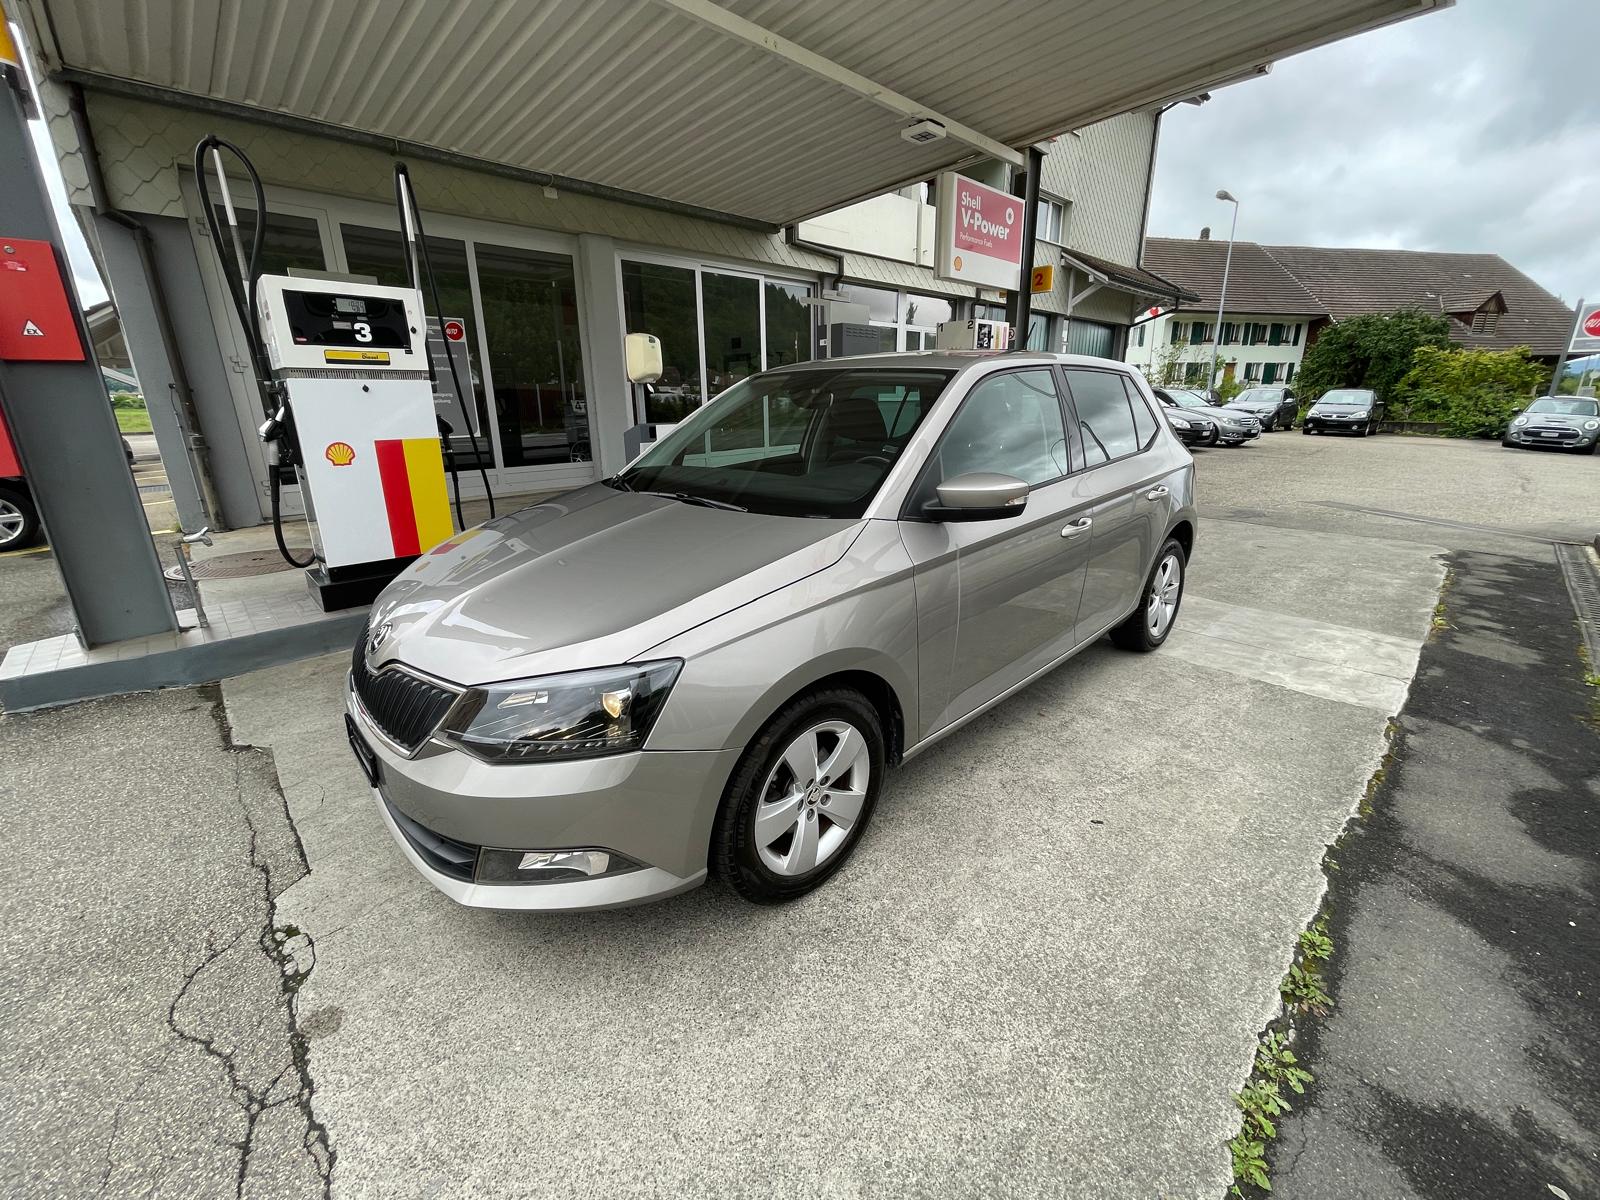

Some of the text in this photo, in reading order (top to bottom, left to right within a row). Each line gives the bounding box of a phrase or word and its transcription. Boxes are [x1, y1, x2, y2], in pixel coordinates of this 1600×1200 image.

[961, 191, 981, 210] Shell
[961, 208, 1010, 240] V-Power
[960, 232, 993, 248] Performance Fuels
[1034, 273, 1043, 286] 2
[354, 323, 372, 342] 3
[967, 320, 974, 329] 2
[983, 337, 989, 347] 2
